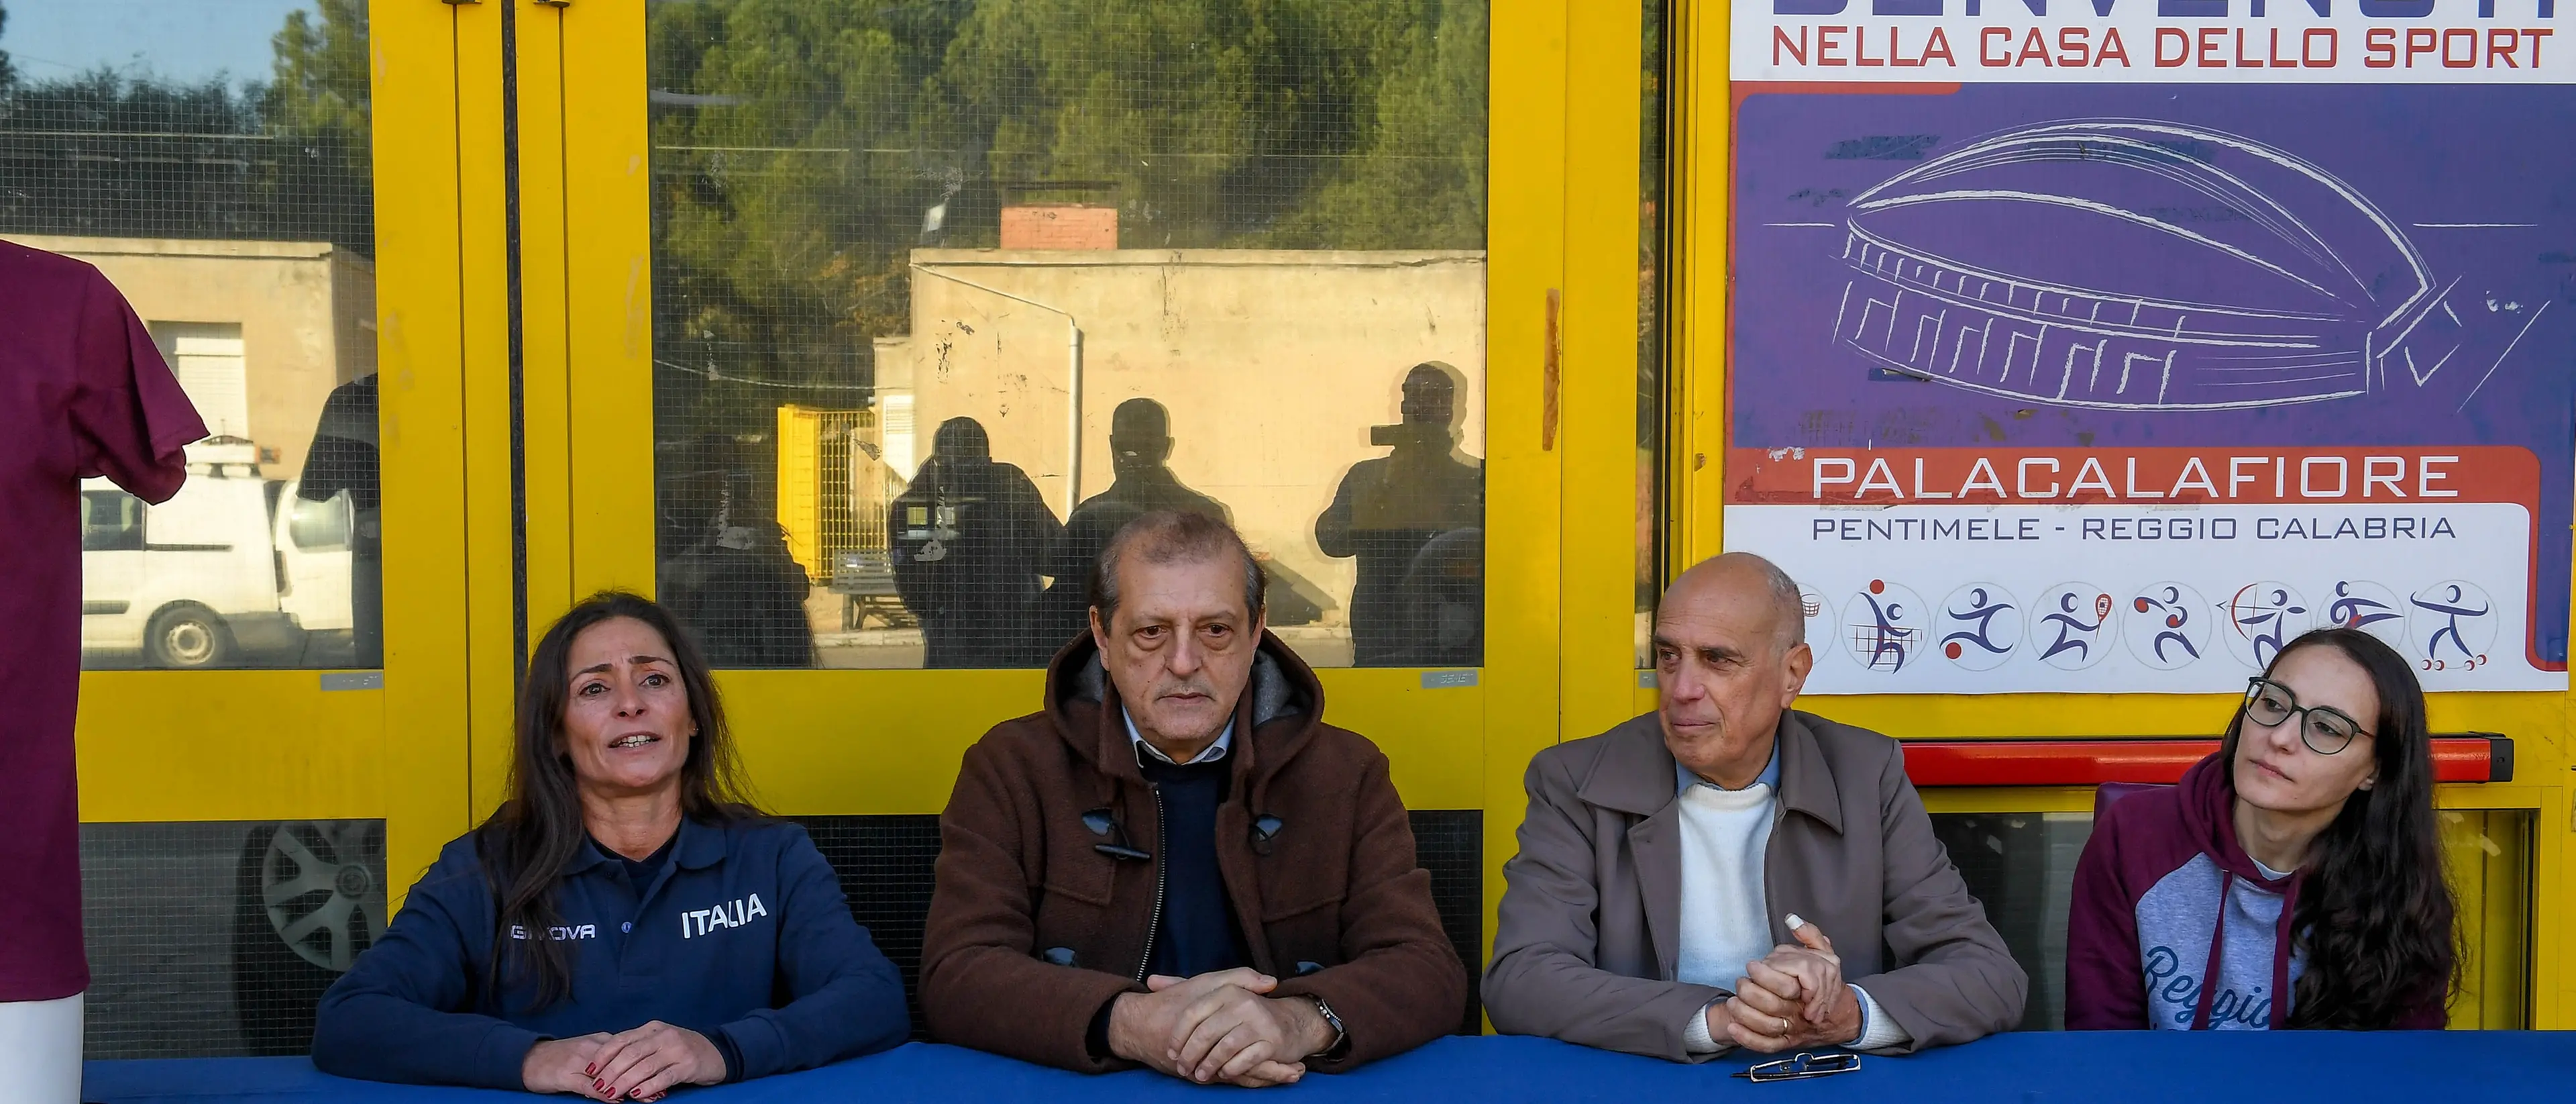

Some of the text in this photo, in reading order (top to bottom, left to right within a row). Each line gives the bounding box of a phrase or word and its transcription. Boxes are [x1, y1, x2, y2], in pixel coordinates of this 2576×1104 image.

[1772, 25, 2554, 69] NELLA CASA DELLO SPORT
[1813, 455, 2460, 499] PALACALAFIORE
[1813, 518, 2040, 541] PENTIMELE
[2082, 517, 2238, 541] REGGIO
[2256, 516, 2457, 540] CALABRIA
[511, 924, 596, 941] GOVA
[681, 893, 767, 939] ITALIA
